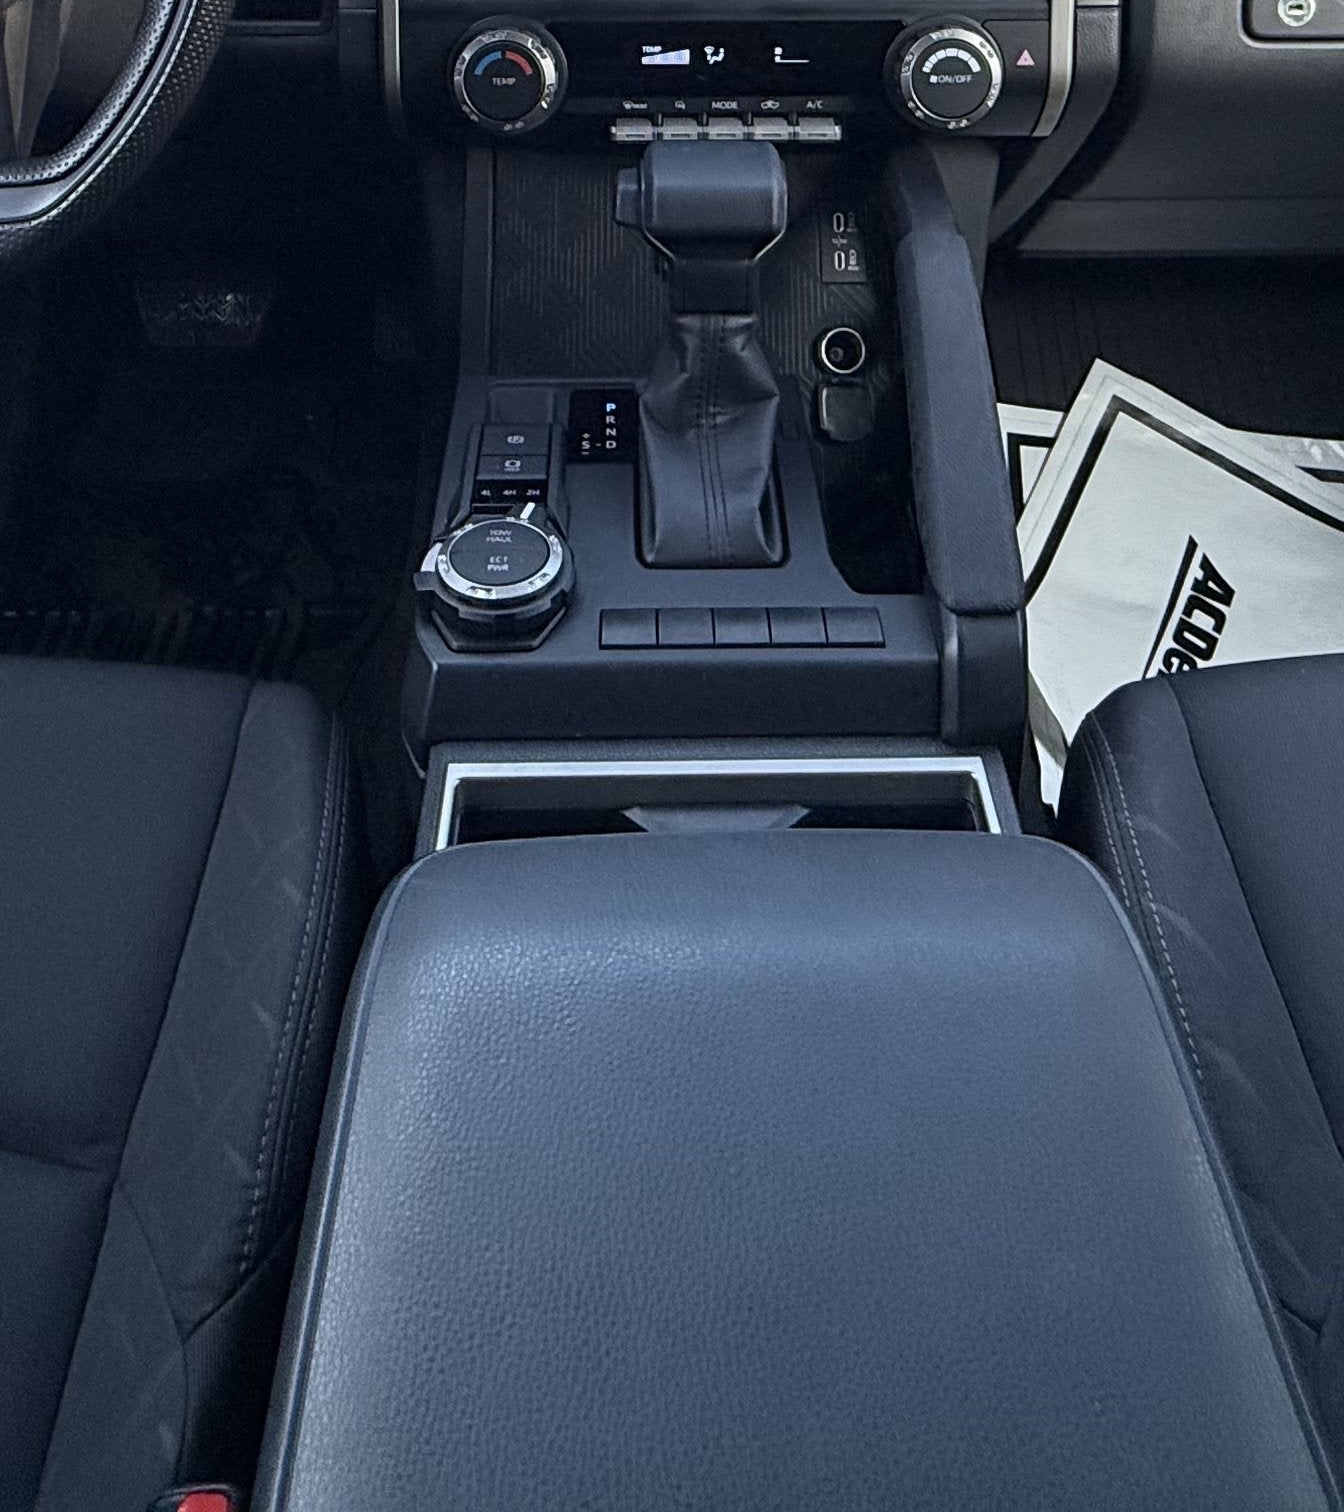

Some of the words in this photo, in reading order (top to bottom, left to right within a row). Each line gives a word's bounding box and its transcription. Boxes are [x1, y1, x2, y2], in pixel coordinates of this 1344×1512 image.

[492, 77, 516, 85] TEMP
[937, 74, 973, 84] ON/OFF
[712, 100, 739, 109] MODE
[806, 100, 824, 110] A/C
[606, 403, 617, 412] P
[606, 416, 616, 424] R
[606, 428, 617, 436] N
[581, 440, 591, 450] S
[606, 441, 617, 449] D
[1157, 552, 1236, 674] ACDe
